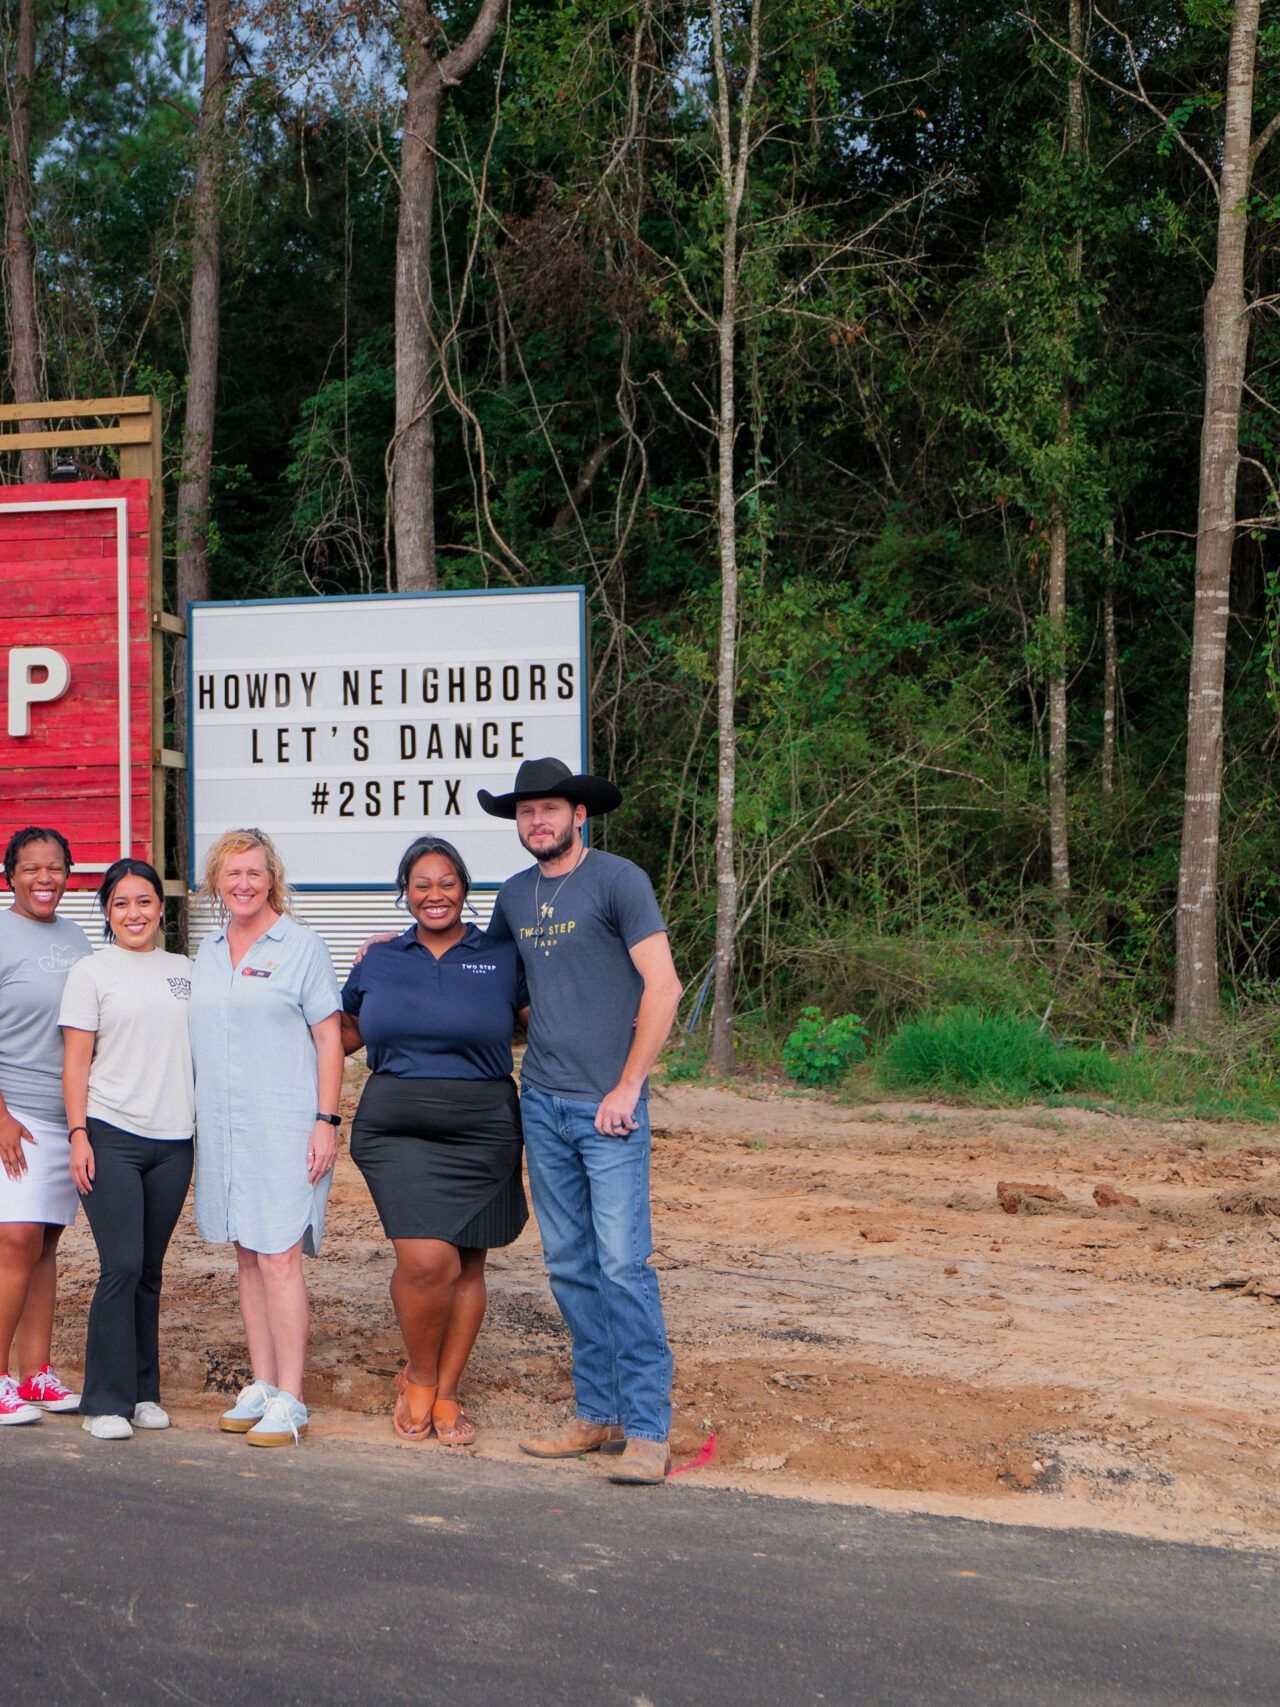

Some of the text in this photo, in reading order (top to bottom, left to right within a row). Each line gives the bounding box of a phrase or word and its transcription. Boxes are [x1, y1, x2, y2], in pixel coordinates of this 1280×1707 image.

[198, 662, 574, 710] HOWDY NEIGHBORS
[252, 721, 524, 764] LET'S DANCE
[311, 779, 462, 817] #2SFTX
[548, 921, 576, 935] STEP
